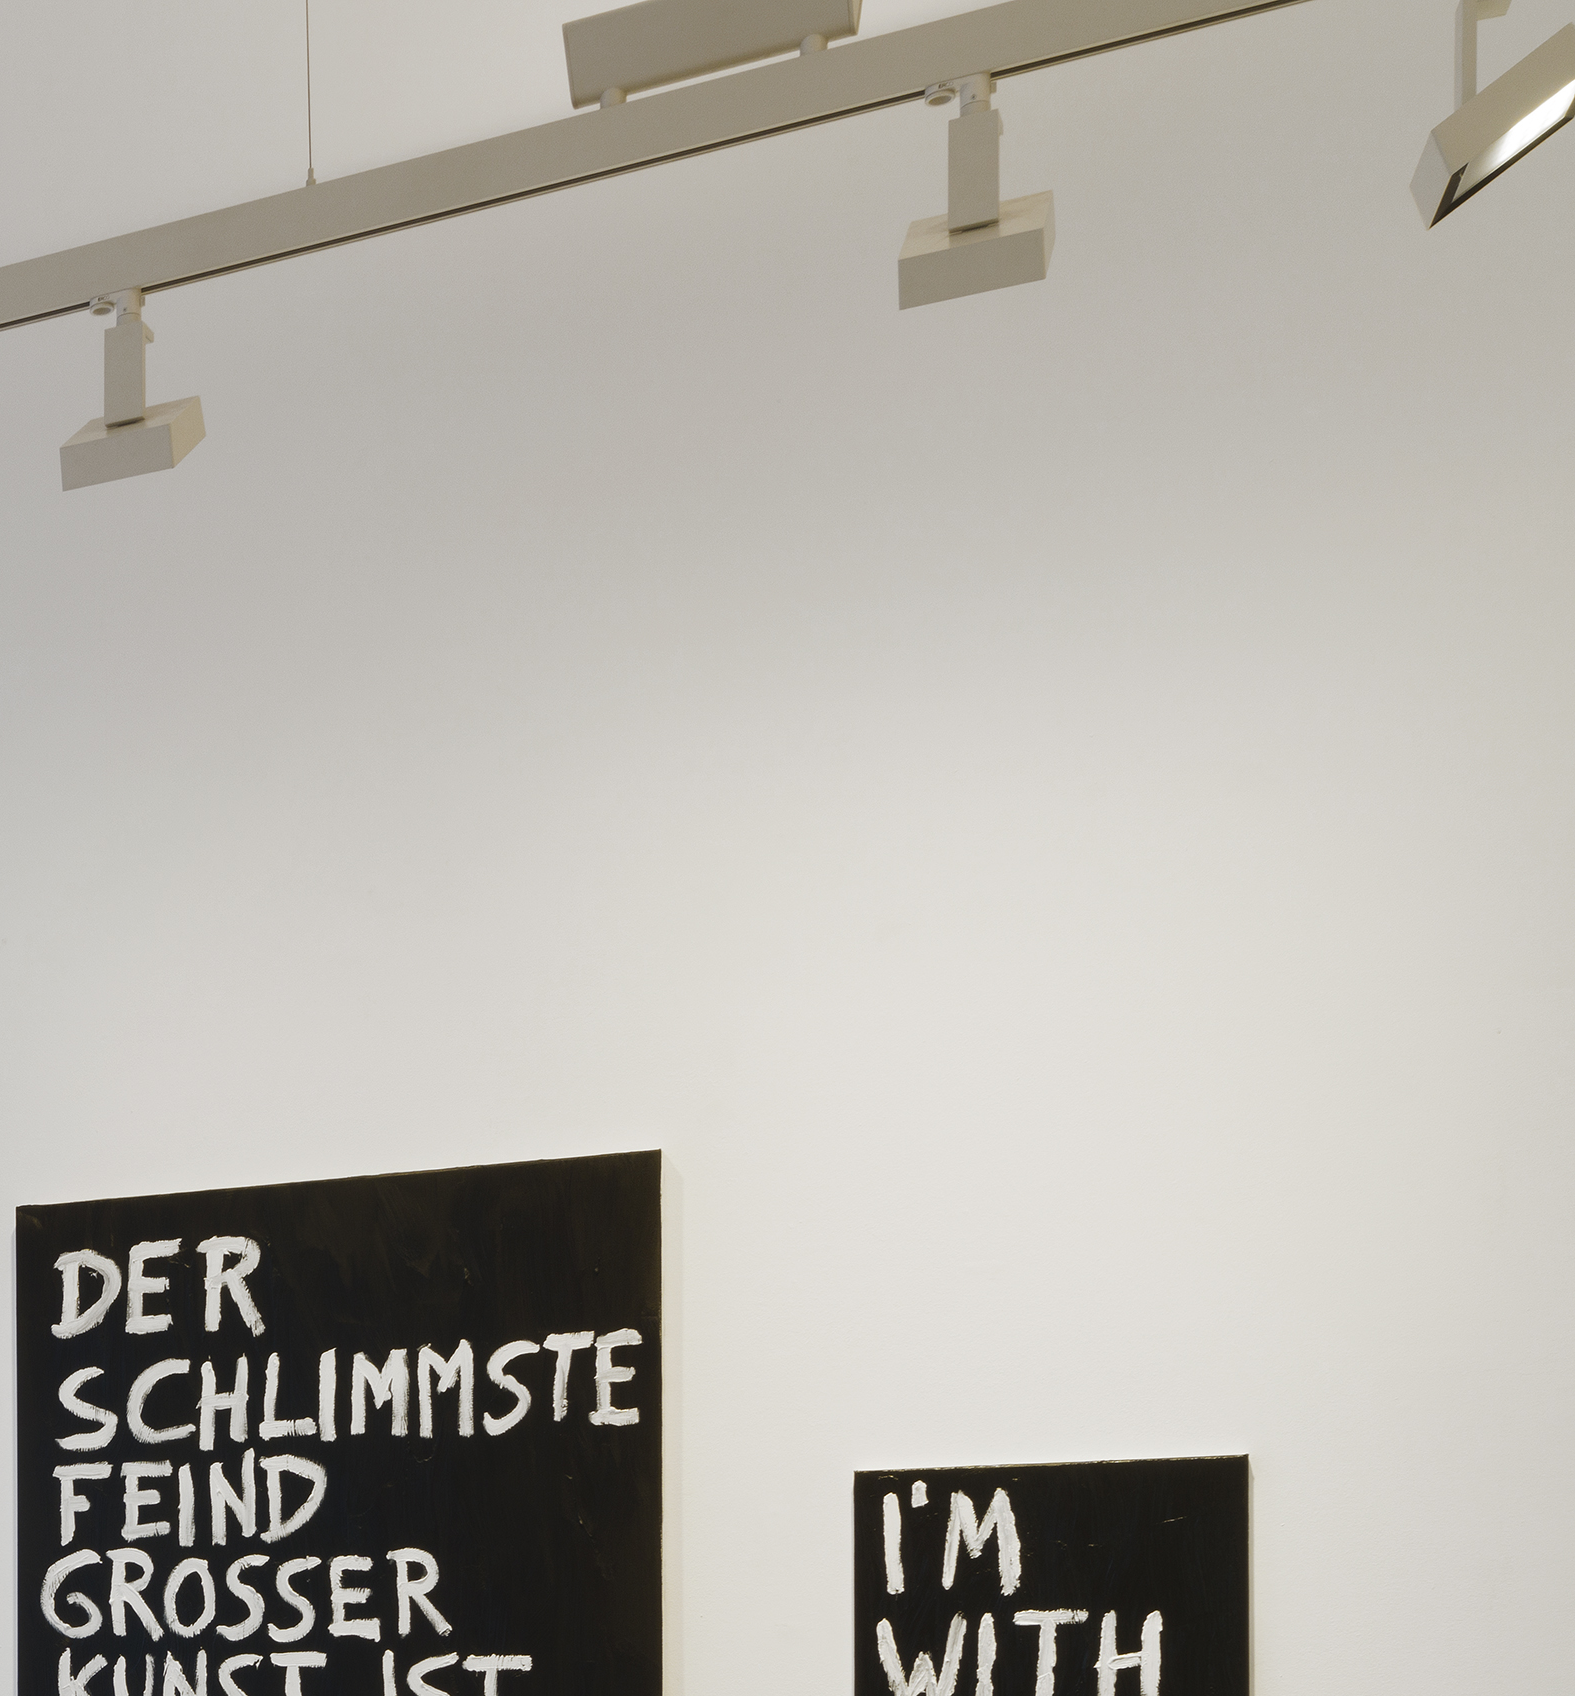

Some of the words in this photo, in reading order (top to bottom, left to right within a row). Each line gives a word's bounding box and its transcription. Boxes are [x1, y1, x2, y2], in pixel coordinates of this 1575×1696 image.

[51, 1236, 265, 1339] DER
[55, 1328, 642, 1451] SCHLIMMSTE
[53, 1448, 327, 1547] FEIND
[883, 1480, 1021, 1596] I'M
[41, 1548, 452, 1642] GROSSER
